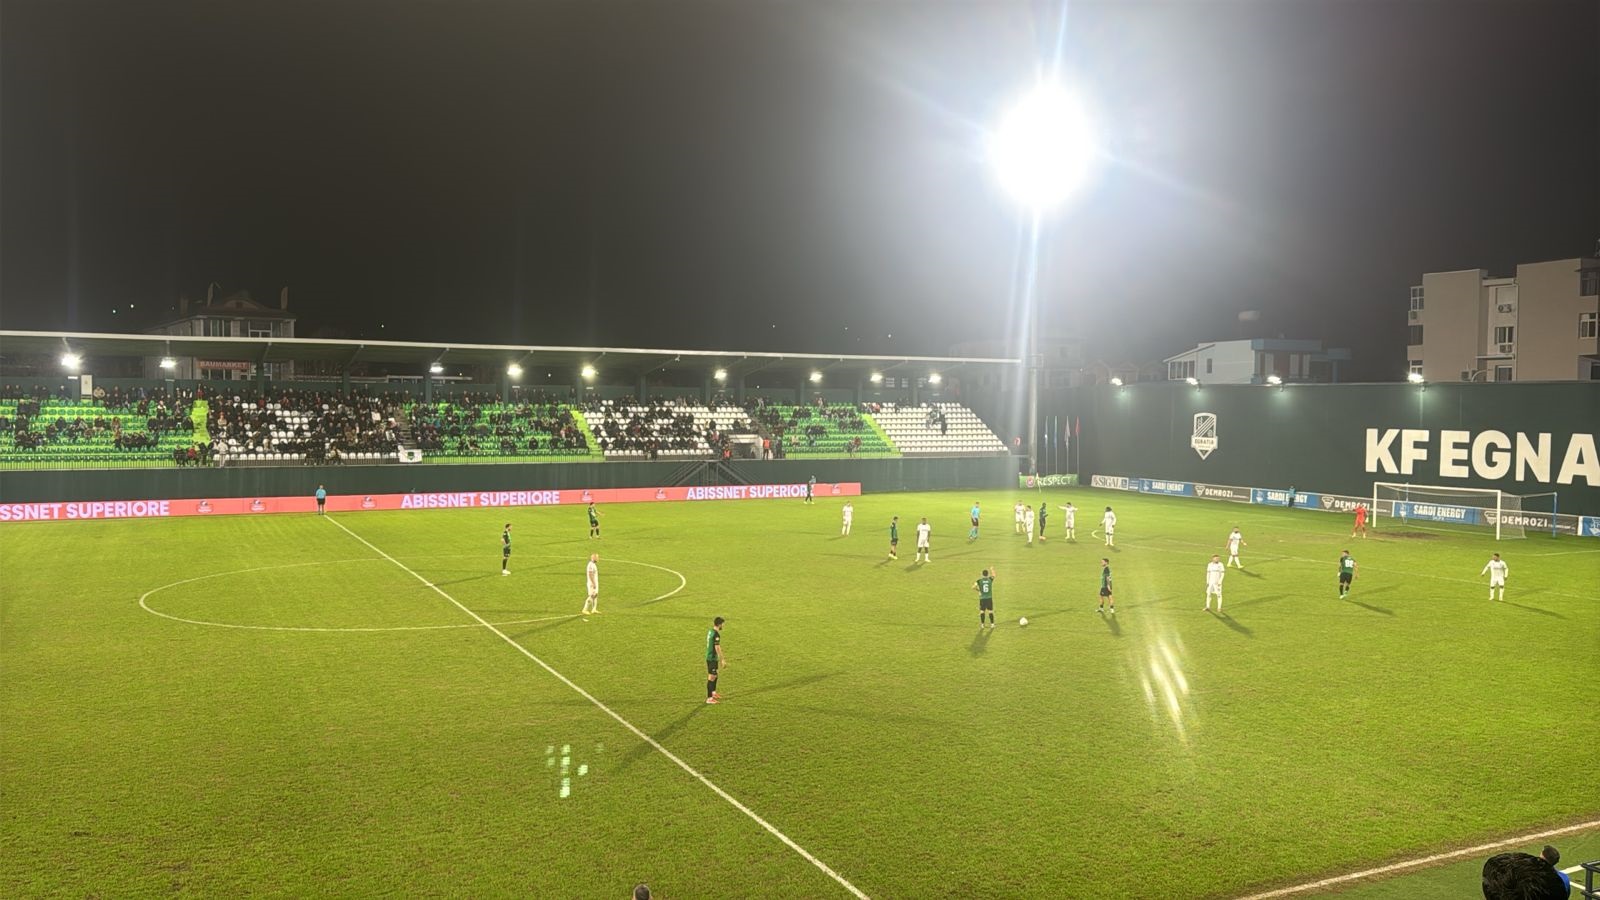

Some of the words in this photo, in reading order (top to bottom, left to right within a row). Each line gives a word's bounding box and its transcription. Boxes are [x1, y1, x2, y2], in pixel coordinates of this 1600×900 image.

[1365, 428, 1430, 475] KF
[1439, 429, 1600, 487] EGNA
[1038, 476, 1072, 487] RESPECT
[401, 493, 480, 509] ABISSNET
[480, 491, 560, 507] SUPERIORE
[687, 486, 748, 500] ABISSNET
[1205, 488, 1233, 498] DEMROZI
[0, 504, 62, 520] SSNET
[66, 500, 170, 519] SUPERIORE
[1413, 505, 1436, 516] SARDI
[1437, 507, 1466, 519] ENERGY
[1501, 515, 1548, 528] DEMROZI
[982, 583, 989, 593] 6
